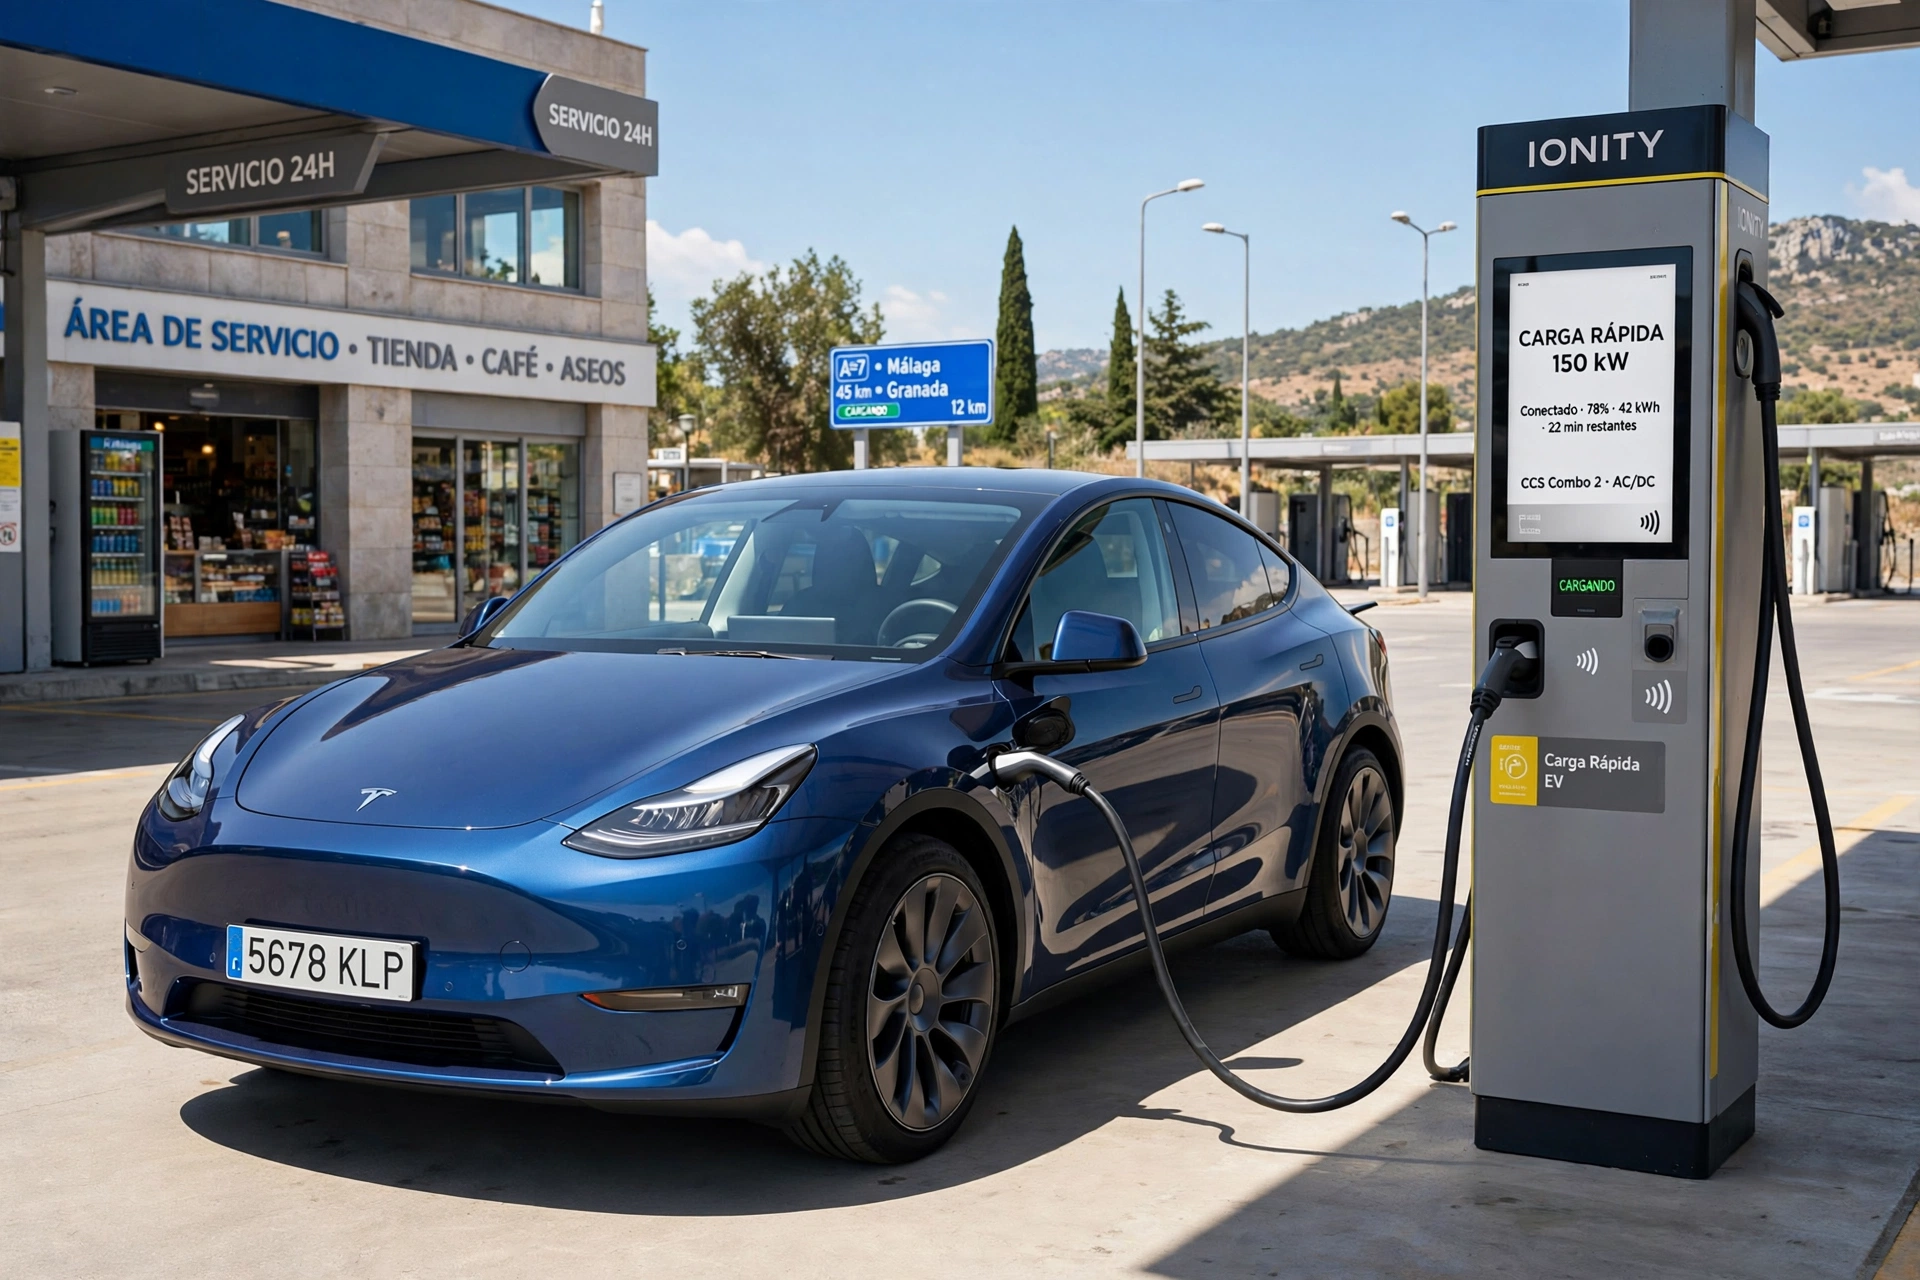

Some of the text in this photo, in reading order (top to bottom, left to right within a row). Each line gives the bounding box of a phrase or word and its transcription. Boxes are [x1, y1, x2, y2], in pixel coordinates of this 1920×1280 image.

[549, 103, 652, 147] SERVICIO 24H
[1528, 129, 1664, 168] IONITY
[186, 151, 335, 195] SERVICIO 24H
[64, 297, 626, 386] ÁREA DE SERVICIO TIENDA CAFÉ ASEOS
[1518, 322, 1664, 347] CARGA RÁPIDA
[887, 356, 941, 378] Málaga
[1552, 351, 1629, 373] 150 kW
[836, 379, 949, 400] 45 km Granada
[951, 399, 986, 415] 12 km
[1520, 401, 1660, 417] Conectado 78% 42 kWh
[1548, 420, 1637, 433] 22 min restantes
[1520, 475, 1656, 490] CCS Combo 2 AC/DC
[1558, 578, 1616, 592] CARGANDO
[1544, 753, 1640, 773] Carga Rápida
[1544, 774, 1564, 788] EV
[248, 936, 404, 990] 5678 KLP
